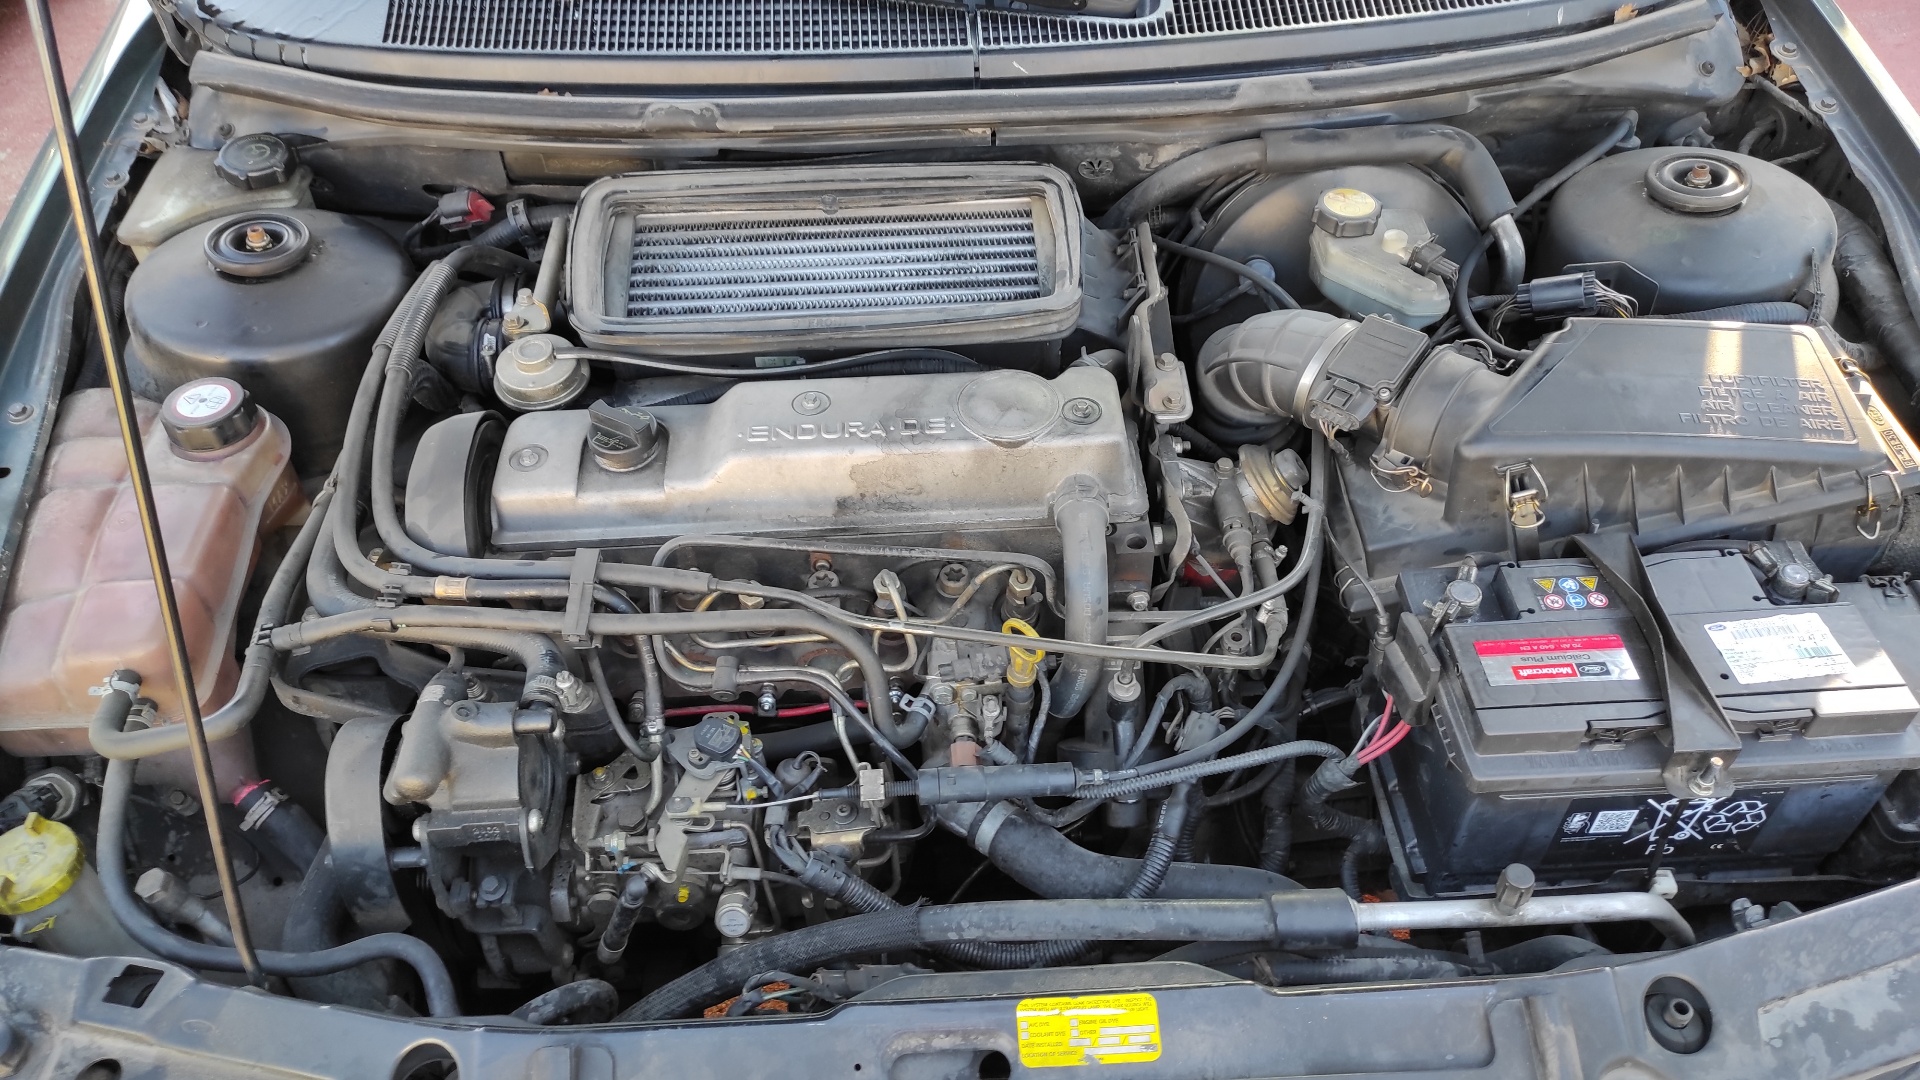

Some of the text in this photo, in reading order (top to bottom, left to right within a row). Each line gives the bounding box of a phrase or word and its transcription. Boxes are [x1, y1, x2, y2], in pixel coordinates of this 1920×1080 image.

[1708, 373, 1826, 390] LUFTFILTER
[1697, 385, 1765, 399] FILTRE
[1798, 391, 1832, 403] AIR
[1701, 400, 1839, 417] AIR CLEANER
[1678, 412, 1845, 431] FILTRO DE AIRE
[747, 418, 947, 443] ENDURA DE
[1546, 653, 1591, 661] Calcium
[1518, 666, 1573, 677] Motorcraft
